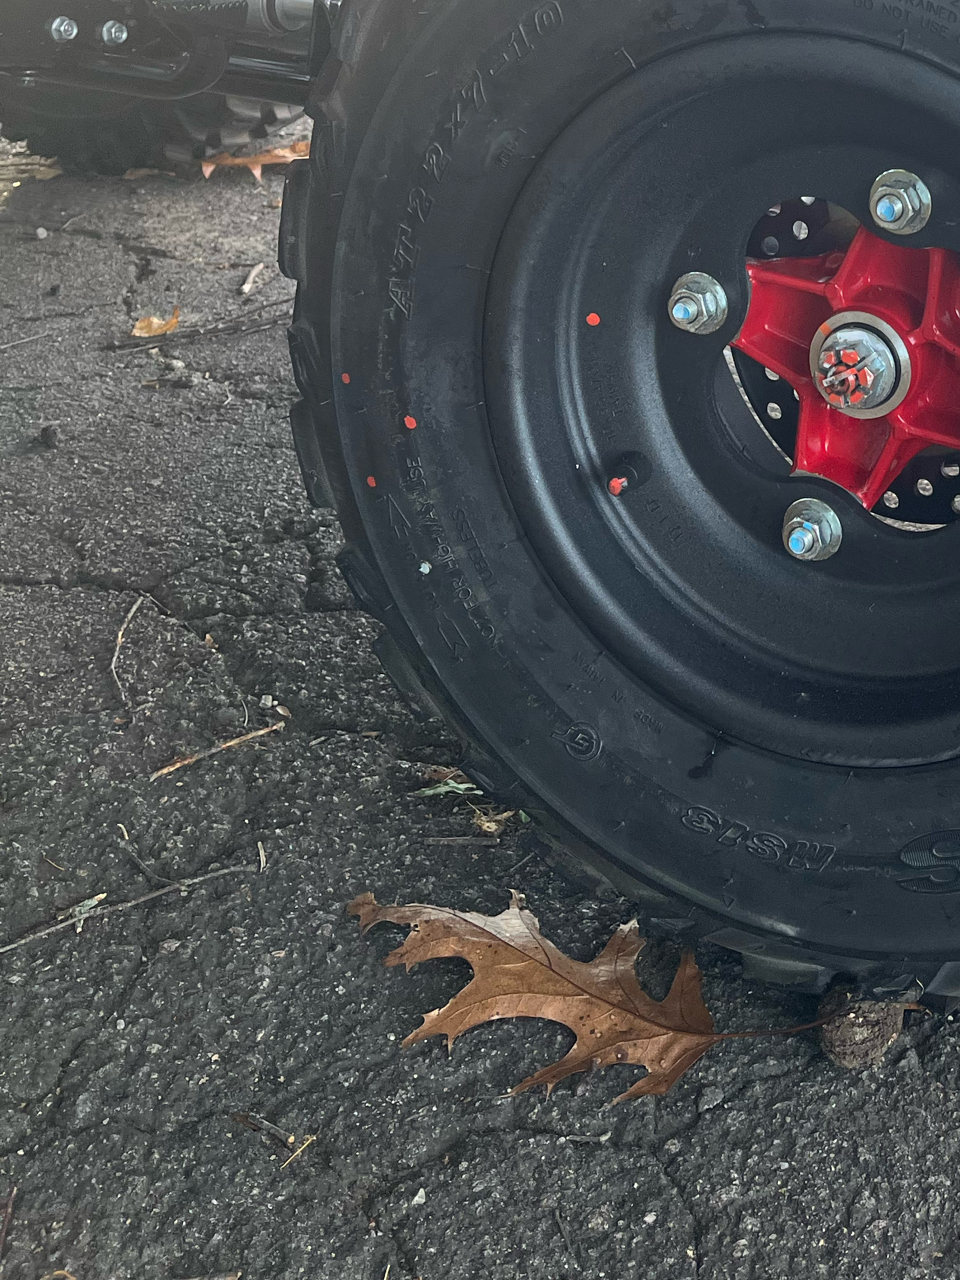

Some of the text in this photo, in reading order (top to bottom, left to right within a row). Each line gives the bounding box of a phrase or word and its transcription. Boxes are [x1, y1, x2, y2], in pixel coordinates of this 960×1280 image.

[881, 2, 911, 23] NOT
[918, 14, 950, 39] USE
[404, 456, 429, 490] USE
[451, 507, 499, 591] TUBELESS
[449, 574, 479, 613] FOR
[470, 612, 503, 650] NOT
[679, 806, 835, 873] MS13
